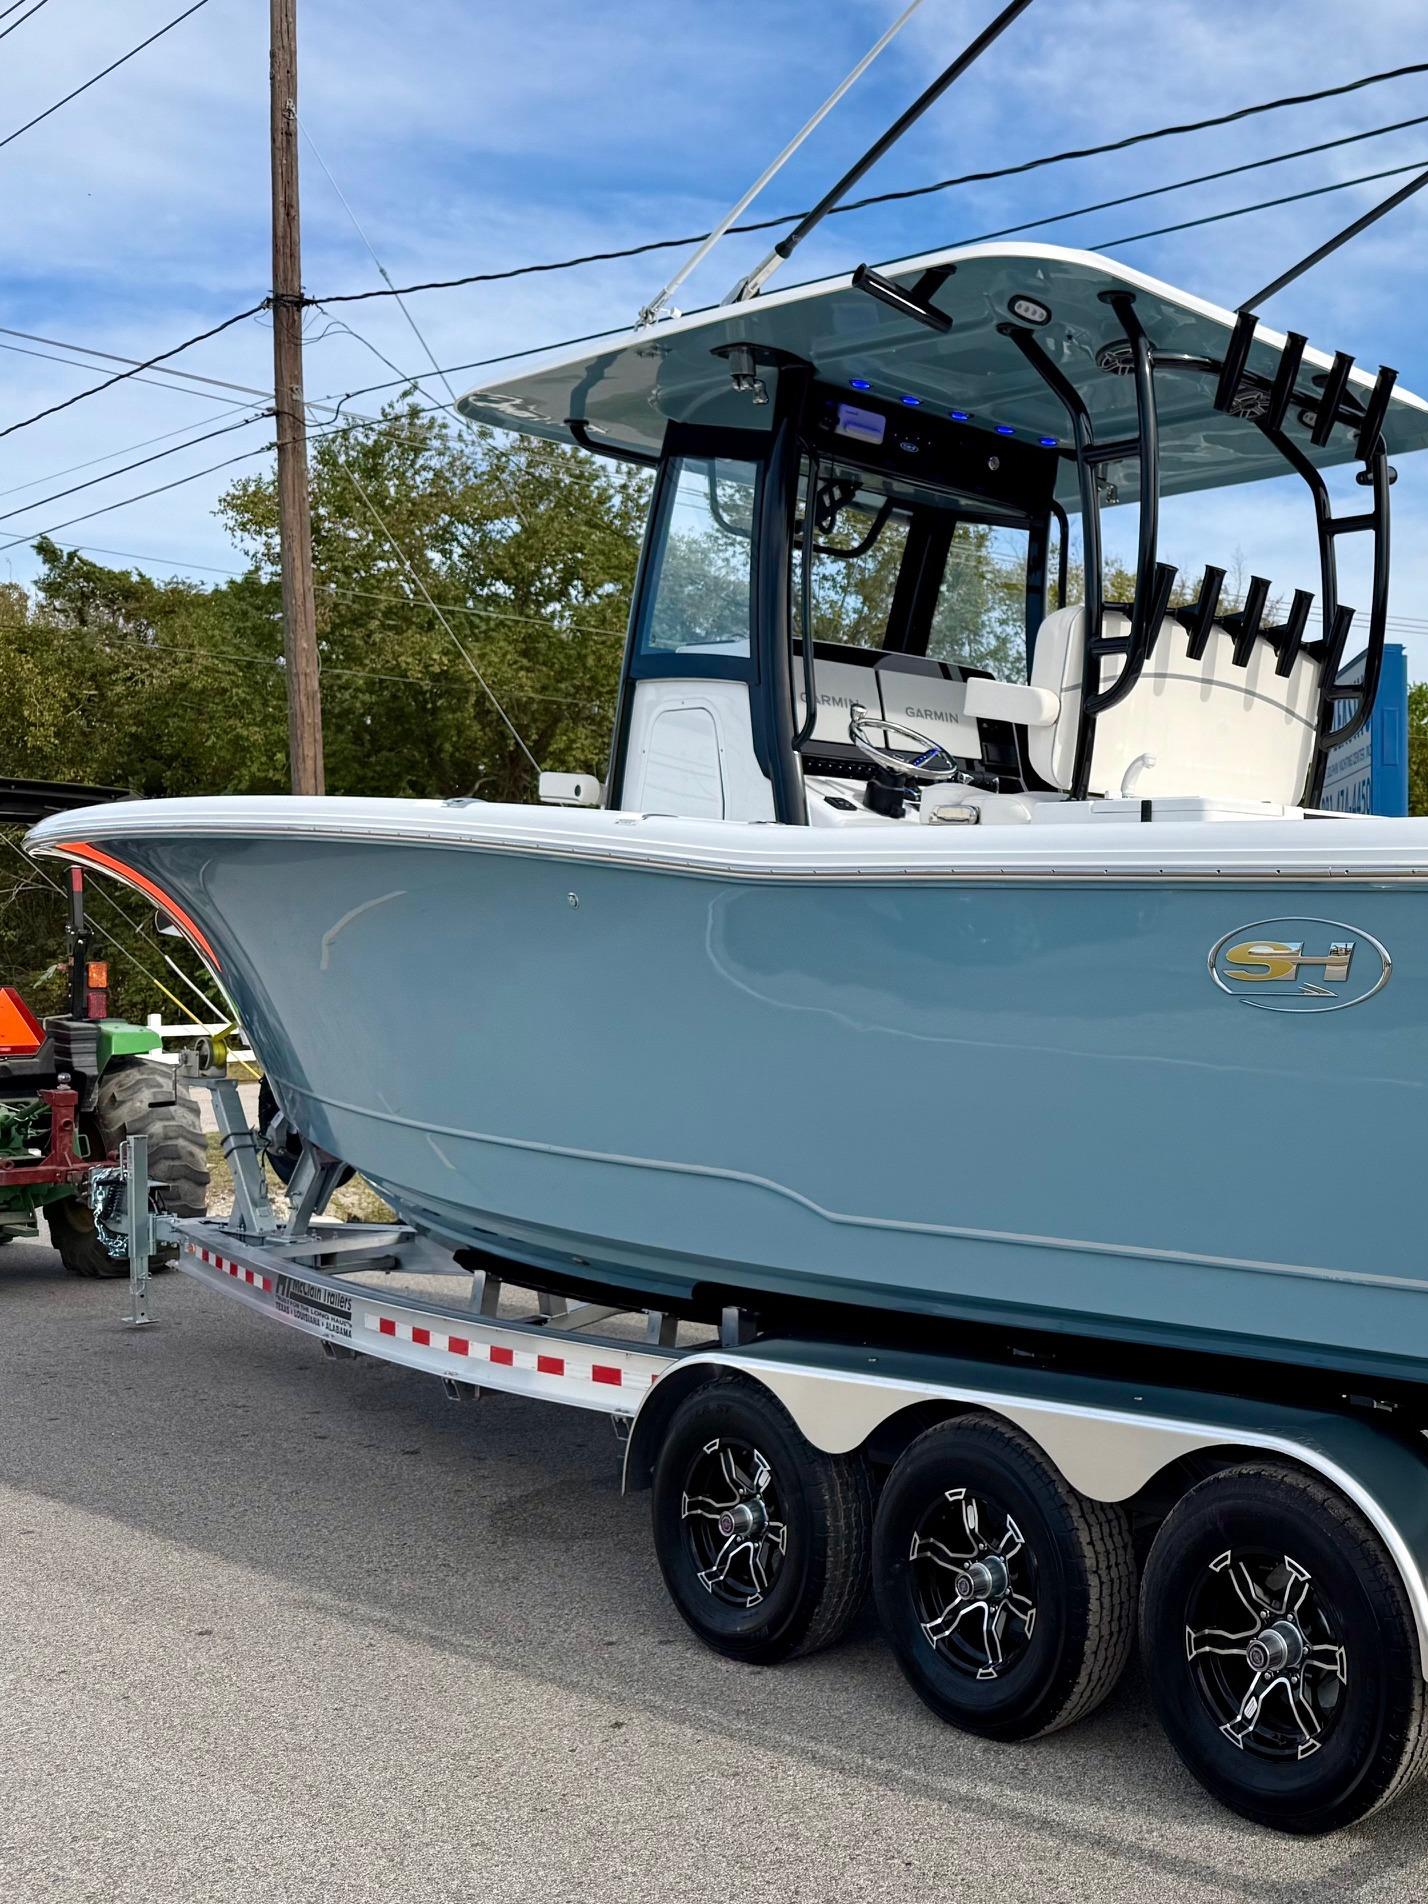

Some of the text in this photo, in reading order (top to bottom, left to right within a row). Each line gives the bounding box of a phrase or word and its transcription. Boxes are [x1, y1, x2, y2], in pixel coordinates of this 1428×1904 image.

[905, 706, 959, 724] GARMIN
[292, 1279, 352, 1311] McClain Trailers
[310, 1308, 330, 1320] LONG
[325, 1321, 352, 1339] ALABAMA
